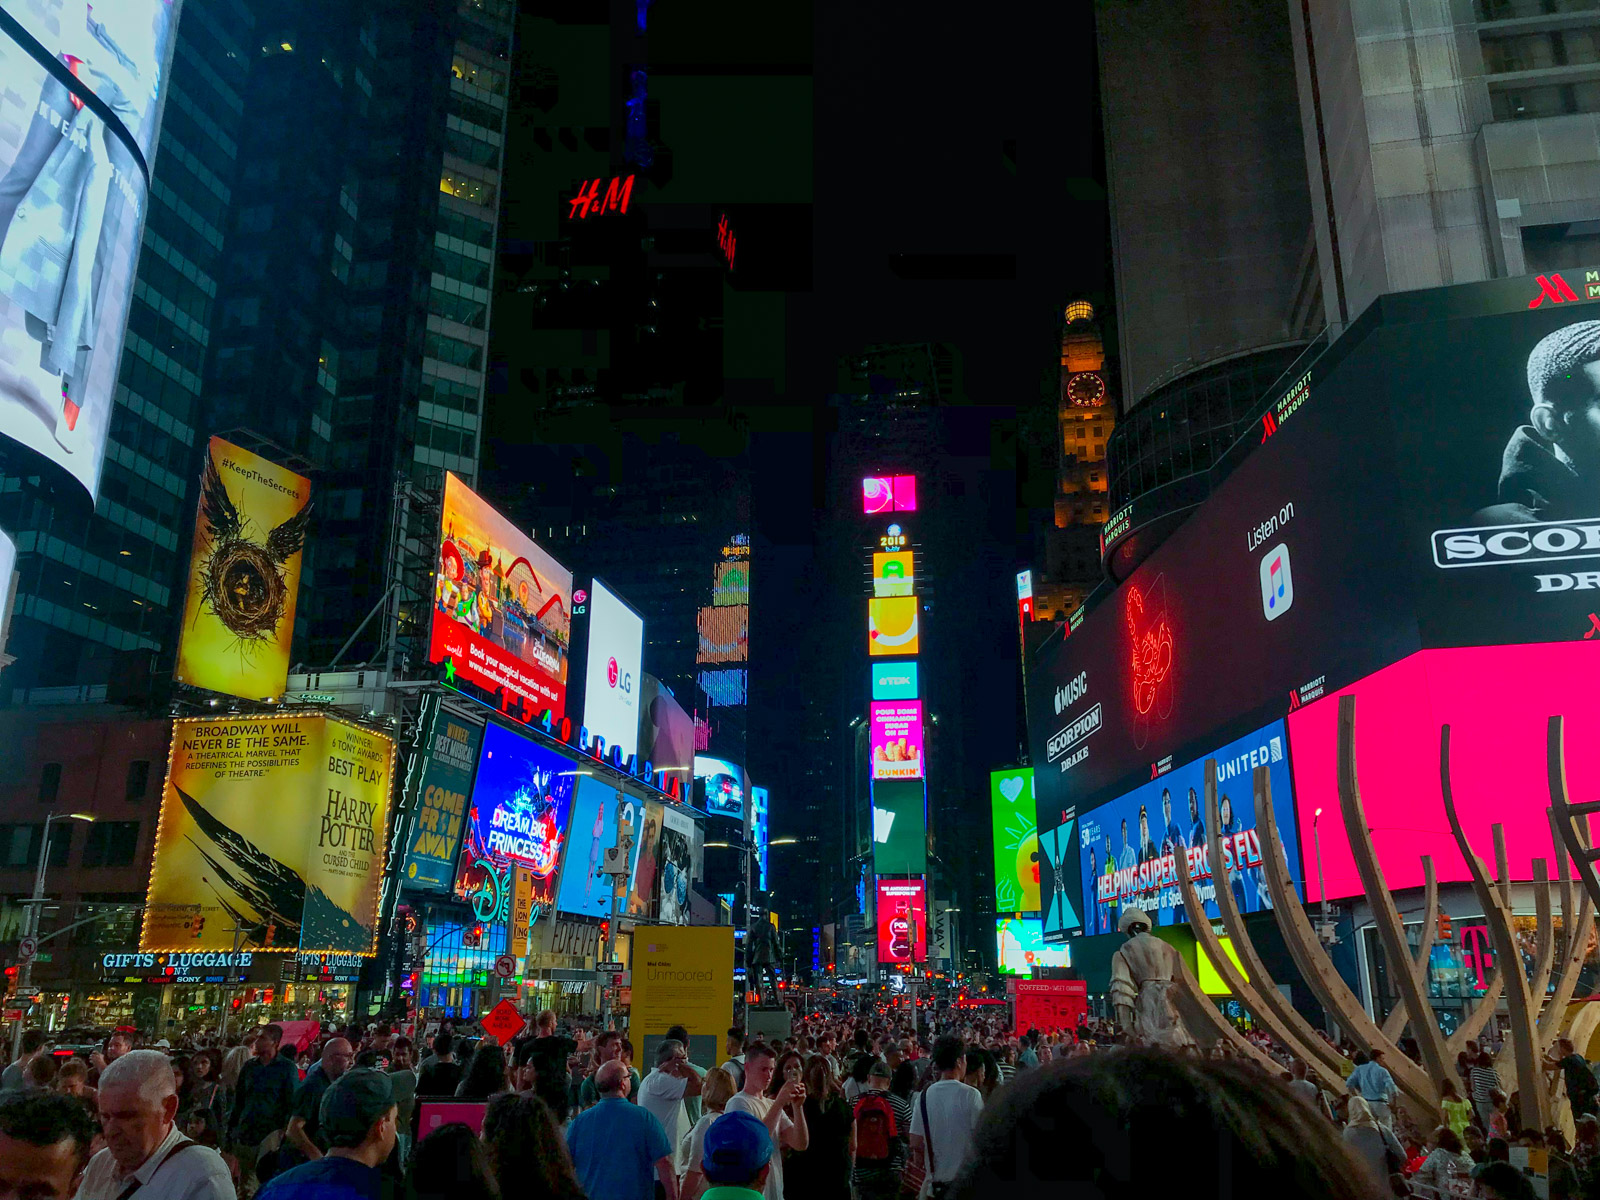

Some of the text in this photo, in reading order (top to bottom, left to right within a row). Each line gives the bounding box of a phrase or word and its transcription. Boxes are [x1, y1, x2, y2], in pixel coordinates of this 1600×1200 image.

[569, 174, 635, 219] H&M
[1277, 371, 1312, 412] MARRIOTT
[1278, 389, 1309, 424] MARQUIS
[222, 458, 300, 499] #KeepTheSecrets
[1104, 505, 1133, 535] MARRIOTT
[1248, 502, 1294, 552] Listen on
[880, 536, 905, 546] 2018
[1105, 520, 1129, 547] MARQUIS
[573, 606, 586, 614] LG
[470, 643, 485, 662] Book
[486, 653, 499, 668] your
[499, 661, 519, 680] magical
[520, 673, 540, 692] vacation
[540, 687, 550, 698] with
[620, 668, 631, 693] LG
[886, 677, 910, 685] TDK
[1061, 671, 1087, 710] MUSIC
[1300, 675, 1325, 694] MARRIOTT
[1301, 686, 1324, 703] MARQUIS
[271, 723, 301, 734] WILL
[346, 731, 373, 749] WINNER!
[1048, 708, 1099, 757] SCORPION
[183, 735, 309, 751] NEVER BE THE SAME.
[197, 751, 245, 760] THEATRICAL
[246, 750, 277, 758] MARVEL
[280, 749, 300, 757] THAT
[332, 739, 383, 763] 6 TONY AWARDS
[434, 733, 451, 755] BEST
[185, 759, 299, 770] REDEFINES THE POSSIBILITIES
[328, 756, 383, 785] BEST PLAY
[1061, 746, 1089, 773] DRAKE
[1217, 745, 1269, 782] UNITED
[215, 770, 226, 778] OF
[326, 788, 378, 828] HARRY
[424, 784, 465, 816] COME
[318, 815, 376, 855] POTTER
[492, 808, 547, 840] DREAM BIG
[413, 831, 457, 860] AWAY
[487, 830, 544, 860] PRINCESS
[323, 853, 369, 871] CURSED CHILD
[1097, 864, 1140, 905] HELPING
[515, 908, 528, 922] LION
[517, 898, 527, 910] THE
[513, 926, 528, 940] KING
[551, 921, 601, 956] FOREVER
[103, 953, 252, 967] GIFTS LUGGAGE
[161, 967, 189, 975] I NY
[325, 953, 362, 967] LUGGAGE
[647, 969, 713, 981] Unmoored
